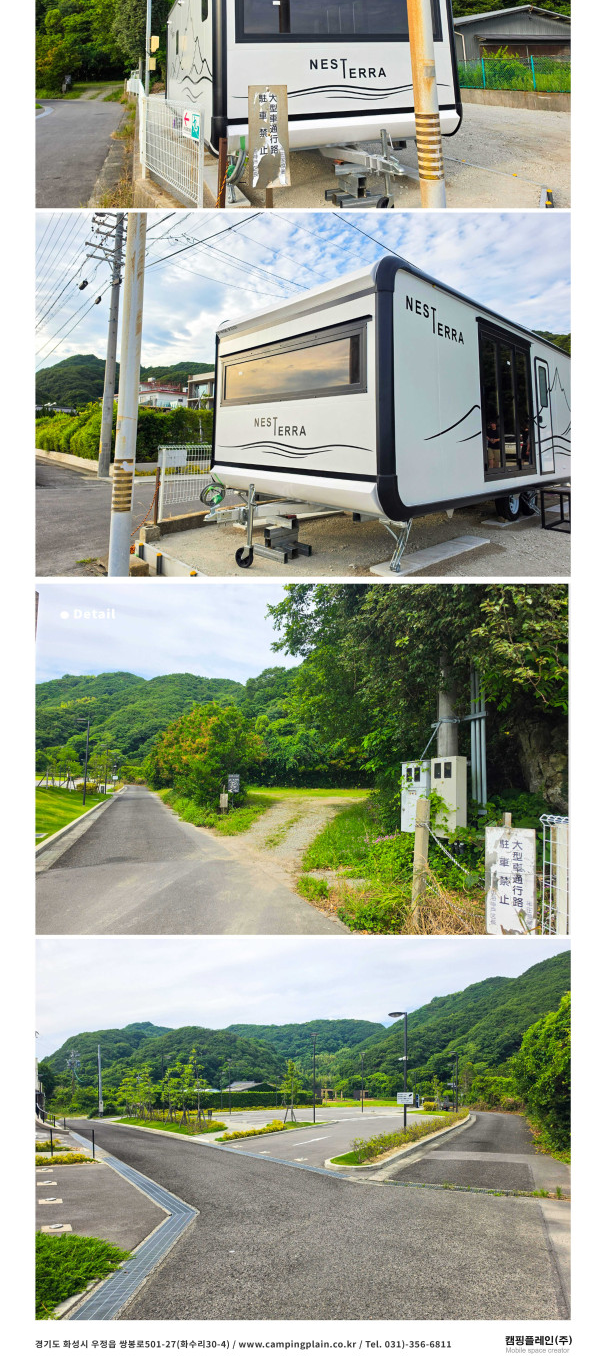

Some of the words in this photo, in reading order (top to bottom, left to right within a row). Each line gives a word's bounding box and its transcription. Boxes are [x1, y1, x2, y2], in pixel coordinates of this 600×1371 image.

[499, 839, 510, 905] 駐車禁止
[512, 840, 524, 908] 大型車通行路
